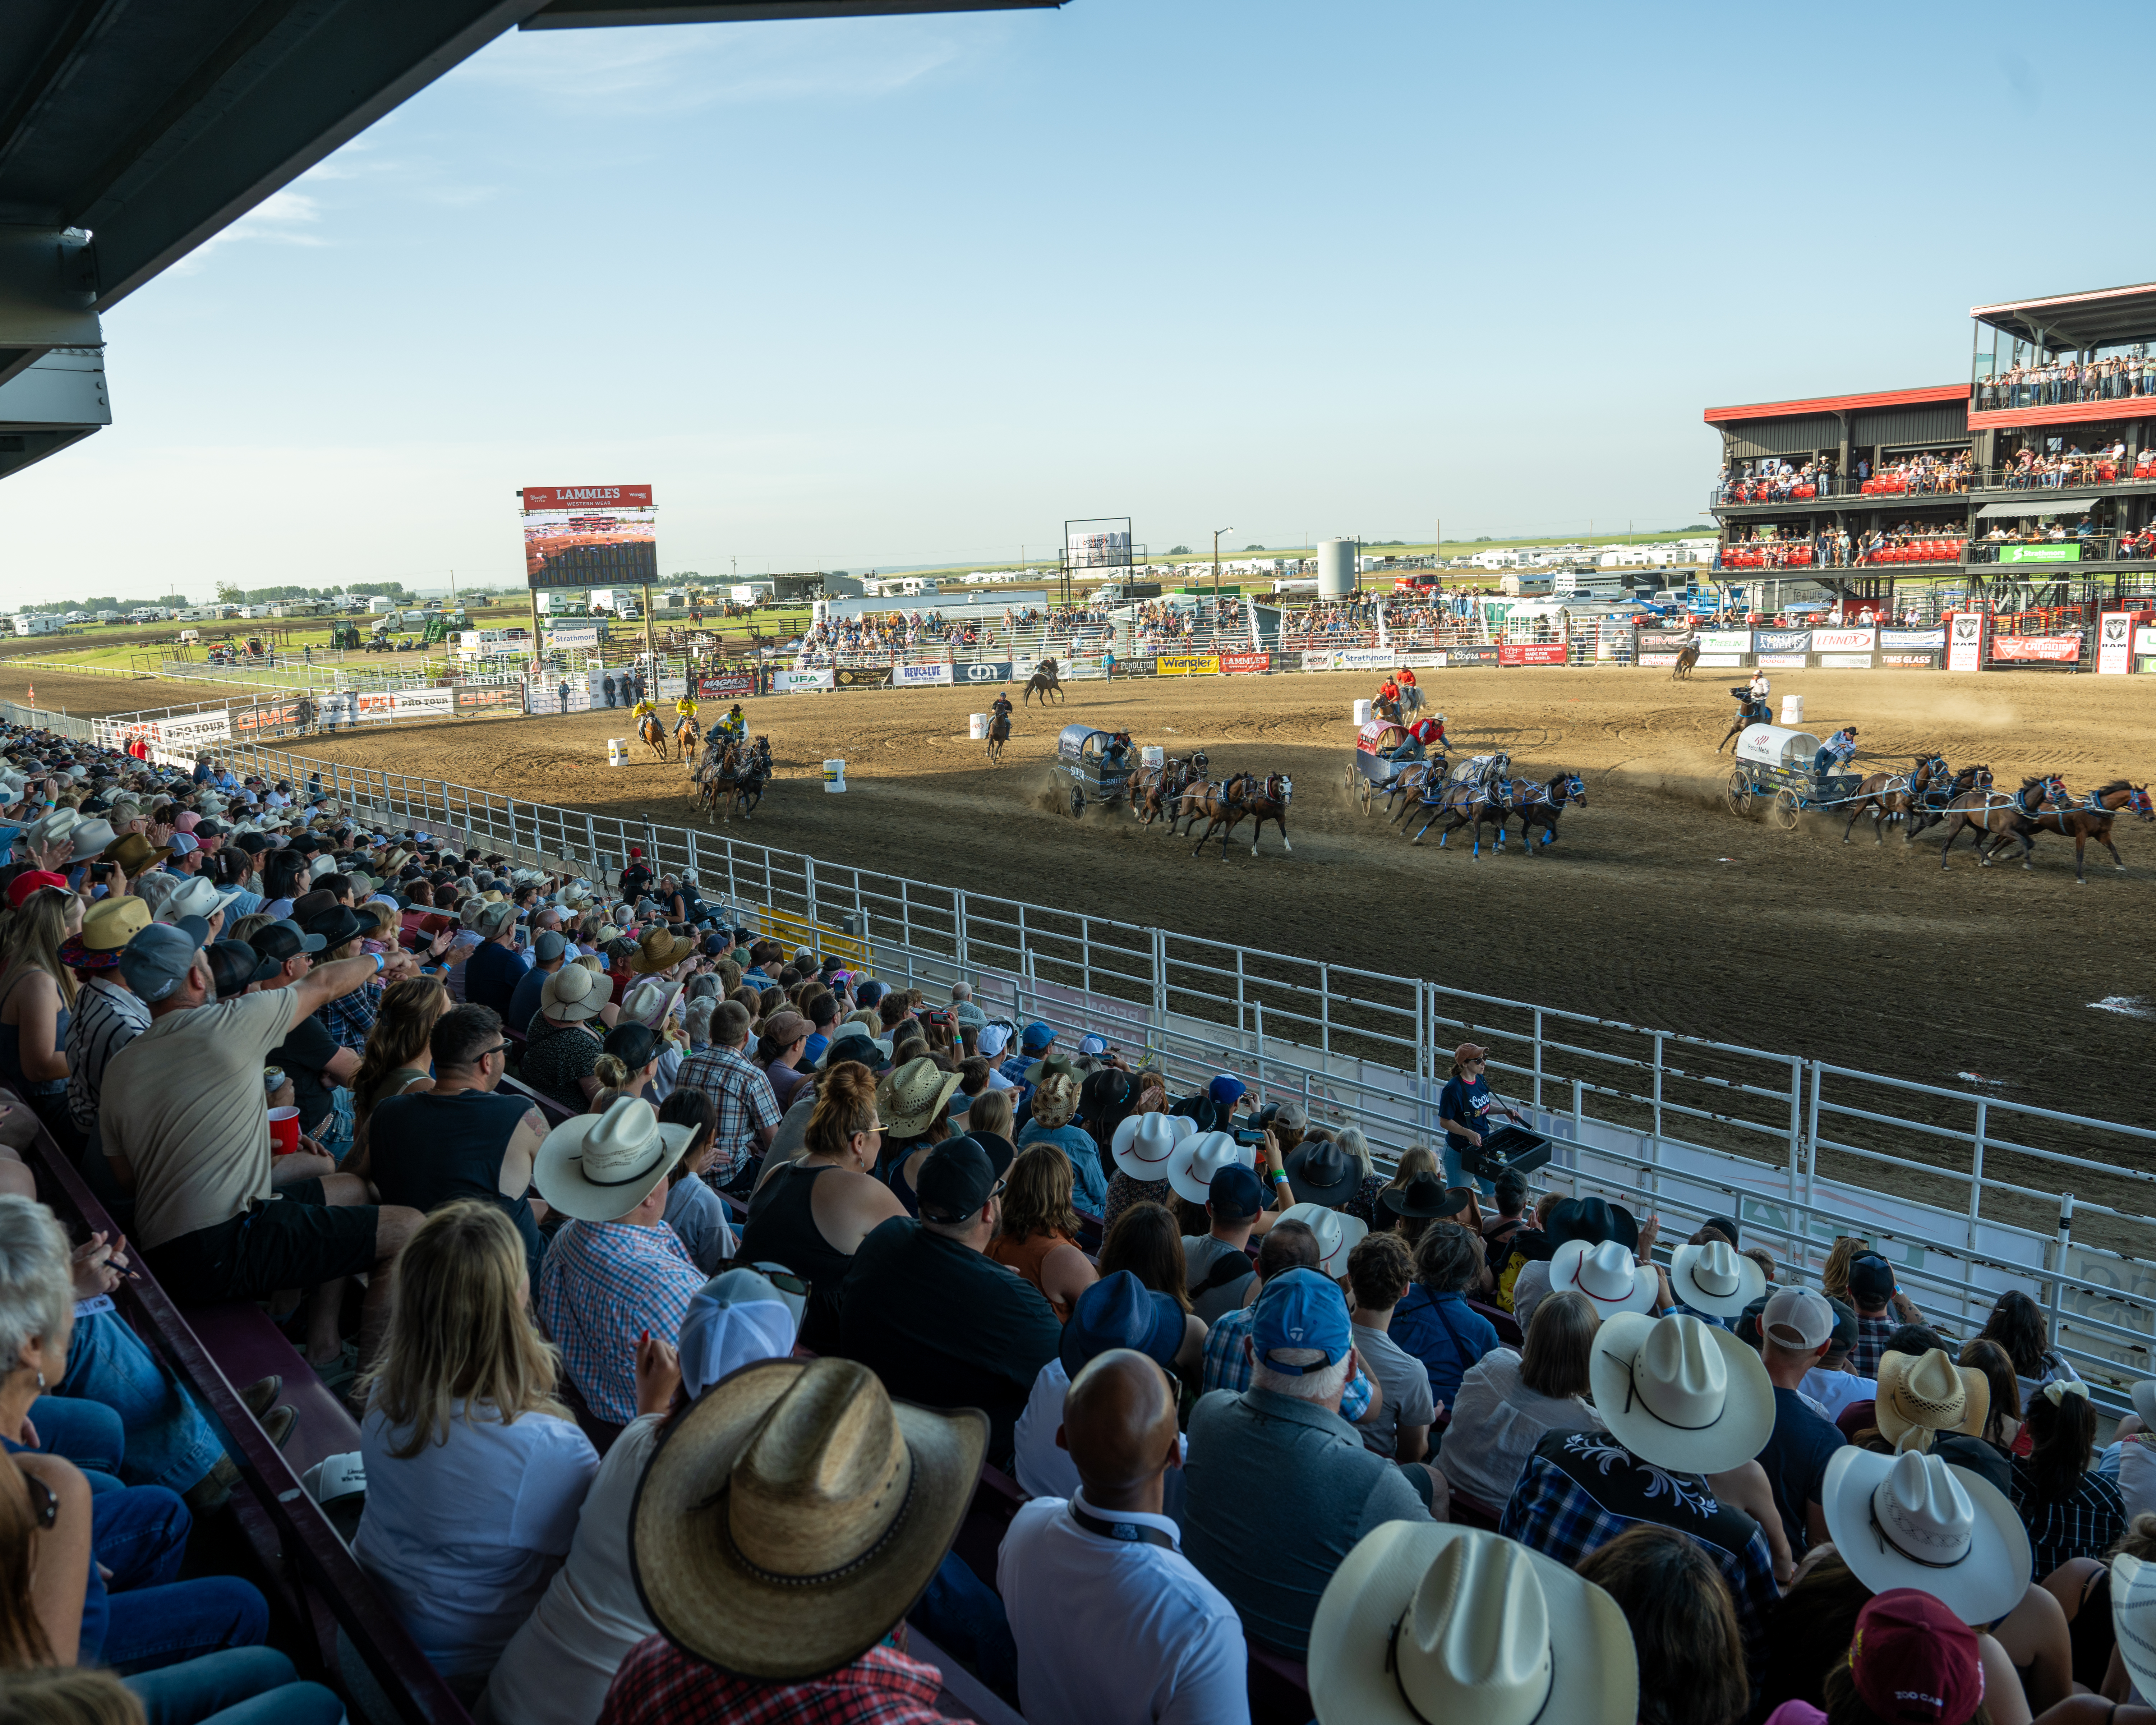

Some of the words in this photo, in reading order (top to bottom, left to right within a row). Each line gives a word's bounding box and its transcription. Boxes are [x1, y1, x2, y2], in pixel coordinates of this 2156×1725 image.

[556, 488, 620, 500] LAMMLE'S
[556, 634, 595, 642] Strathmore
[1641, 635, 1688, 645] GMC
[1759, 635, 1806, 644] FORTIS
[1816, 636, 1860, 645] LENNOX
[1222, 656, 1267, 665] LAMMLE'S
[1454, 650, 1479, 661] Coors
[2038, 651, 2061, 659] TIRE
[1120, 660, 1155, 670] PENDLETON
[1162, 658, 1212, 672] Wrangler
[702, 676, 752, 688] MAGNUM
[459, 690, 513, 705] GMC
[533, 697, 584, 708] DIODE
[324, 704, 353, 713] WPCA
[238, 704, 300, 730] GMC
[194, 721, 225, 734] TOUR
[1064, 732, 1072, 740] David
[1070, 733, 1079, 744] Bexte
[1748, 743, 1770, 755] ReconMetal
[1071, 765, 1085, 782] SNIPER
[1777, 767, 1789, 775] solutions
